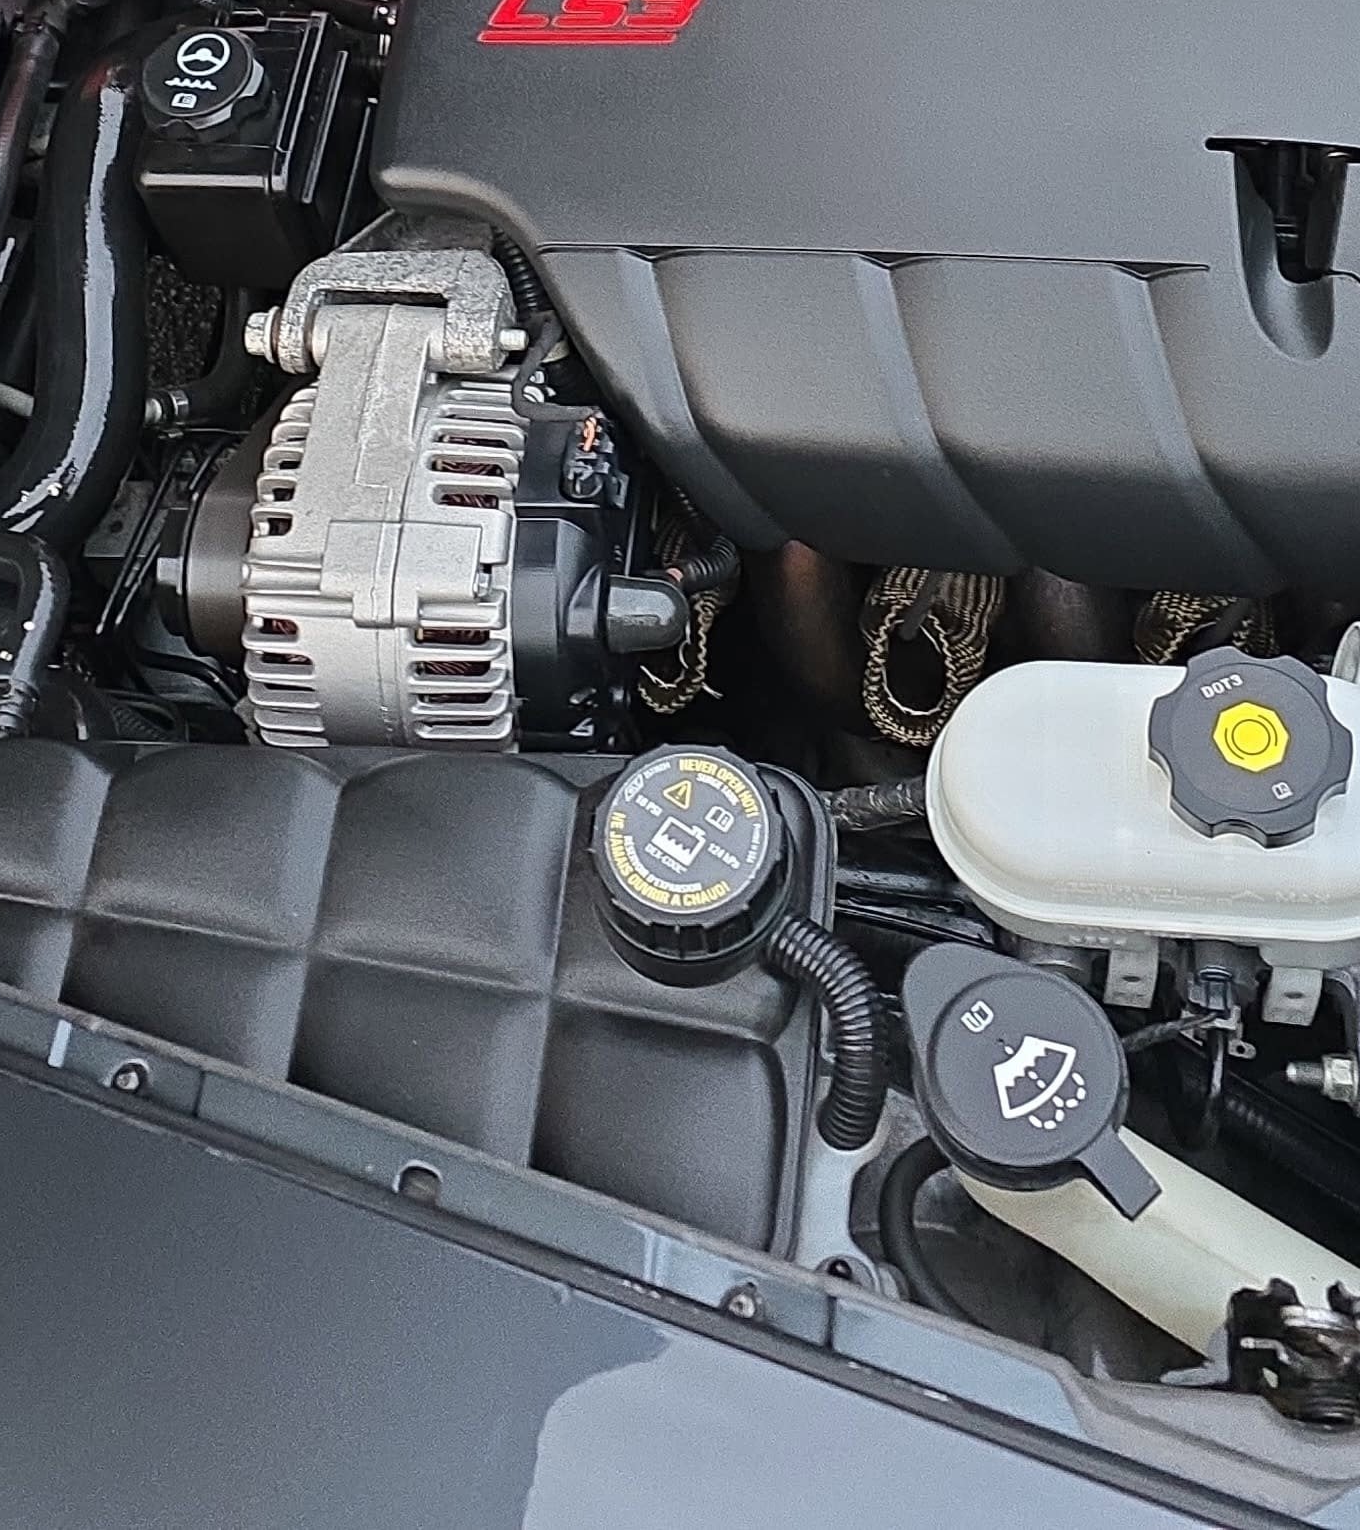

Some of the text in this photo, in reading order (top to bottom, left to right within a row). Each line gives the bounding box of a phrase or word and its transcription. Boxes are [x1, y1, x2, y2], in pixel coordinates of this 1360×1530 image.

[1200, 674, 1244, 699] DOT3
[679, 758, 718, 776] NEVER
[715, 767, 746, 794] OPEN
[738, 790, 760, 818] HOT!
[610, 811, 627, 829] NE
[645, 801, 663, 817] PSI
[609, 830, 634, 877] JAMAIS
[627, 872, 671, 905] OUVRIR
[681, 880, 731, 907] CHAUD!
